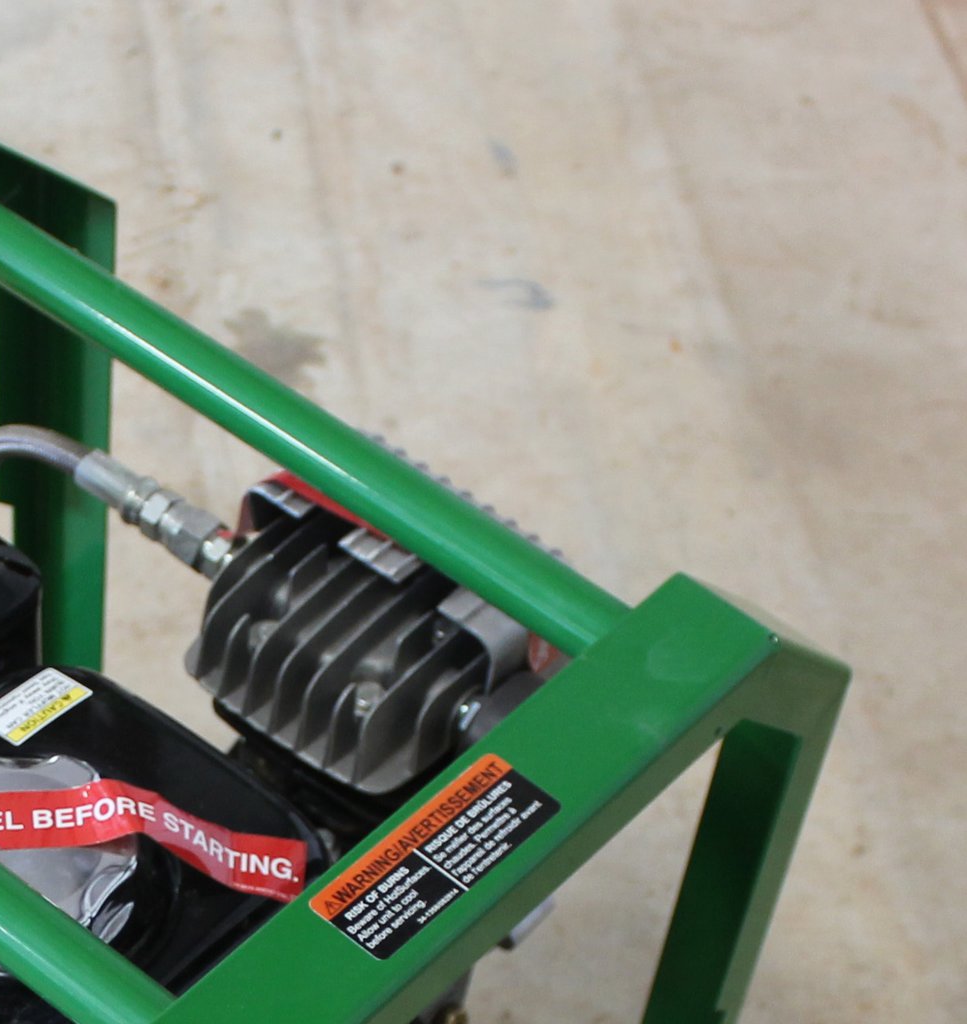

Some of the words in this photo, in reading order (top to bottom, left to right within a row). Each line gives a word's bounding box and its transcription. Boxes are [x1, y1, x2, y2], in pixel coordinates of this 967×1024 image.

[18, 700, 64, 732] CAUTION
[33, 798, 155, 829] BEFORE
[164, 813, 299, 883] STARTING.
[329, 760, 507, 905] WARNING/AVERTISSEMENT
[423, 824, 459, 854] RISQUE
[453, 814, 471, 829] DE
[431, 849, 448, 863] Se
[465, 819, 484, 835] des
[343, 899, 369, 921] RISK
[363, 889, 381, 904] OF
[376, 865, 410, 893] BURNS
[346, 907, 379, 934] Beware
[374, 899, 387, 911] of
[355, 920, 381, 942] Allow
[375, 908, 395, 925] unit
[389, 901, 403, 913] to
[398, 888, 419, 906] cool
[364, 925, 394, 949] before
[388, 896, 429, 930] servicing.
